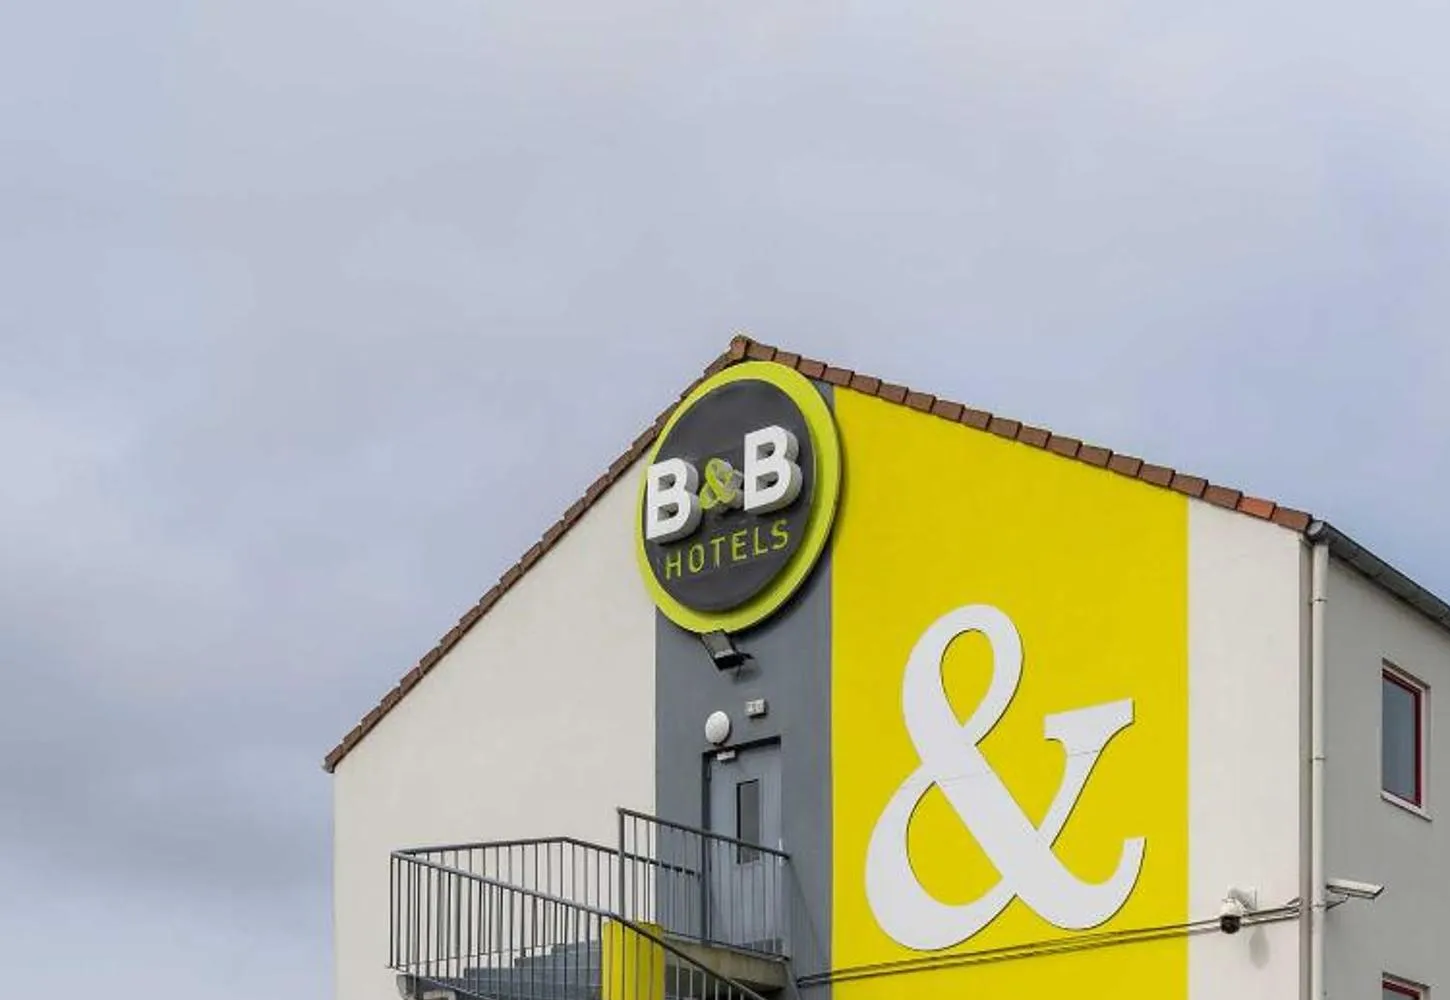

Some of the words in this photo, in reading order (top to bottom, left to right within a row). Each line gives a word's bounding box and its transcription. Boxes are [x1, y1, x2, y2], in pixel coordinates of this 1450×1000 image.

[646, 425, 802, 544] B&B
[665, 519, 791, 580] HOTELS
[864, 603, 1147, 951] &
